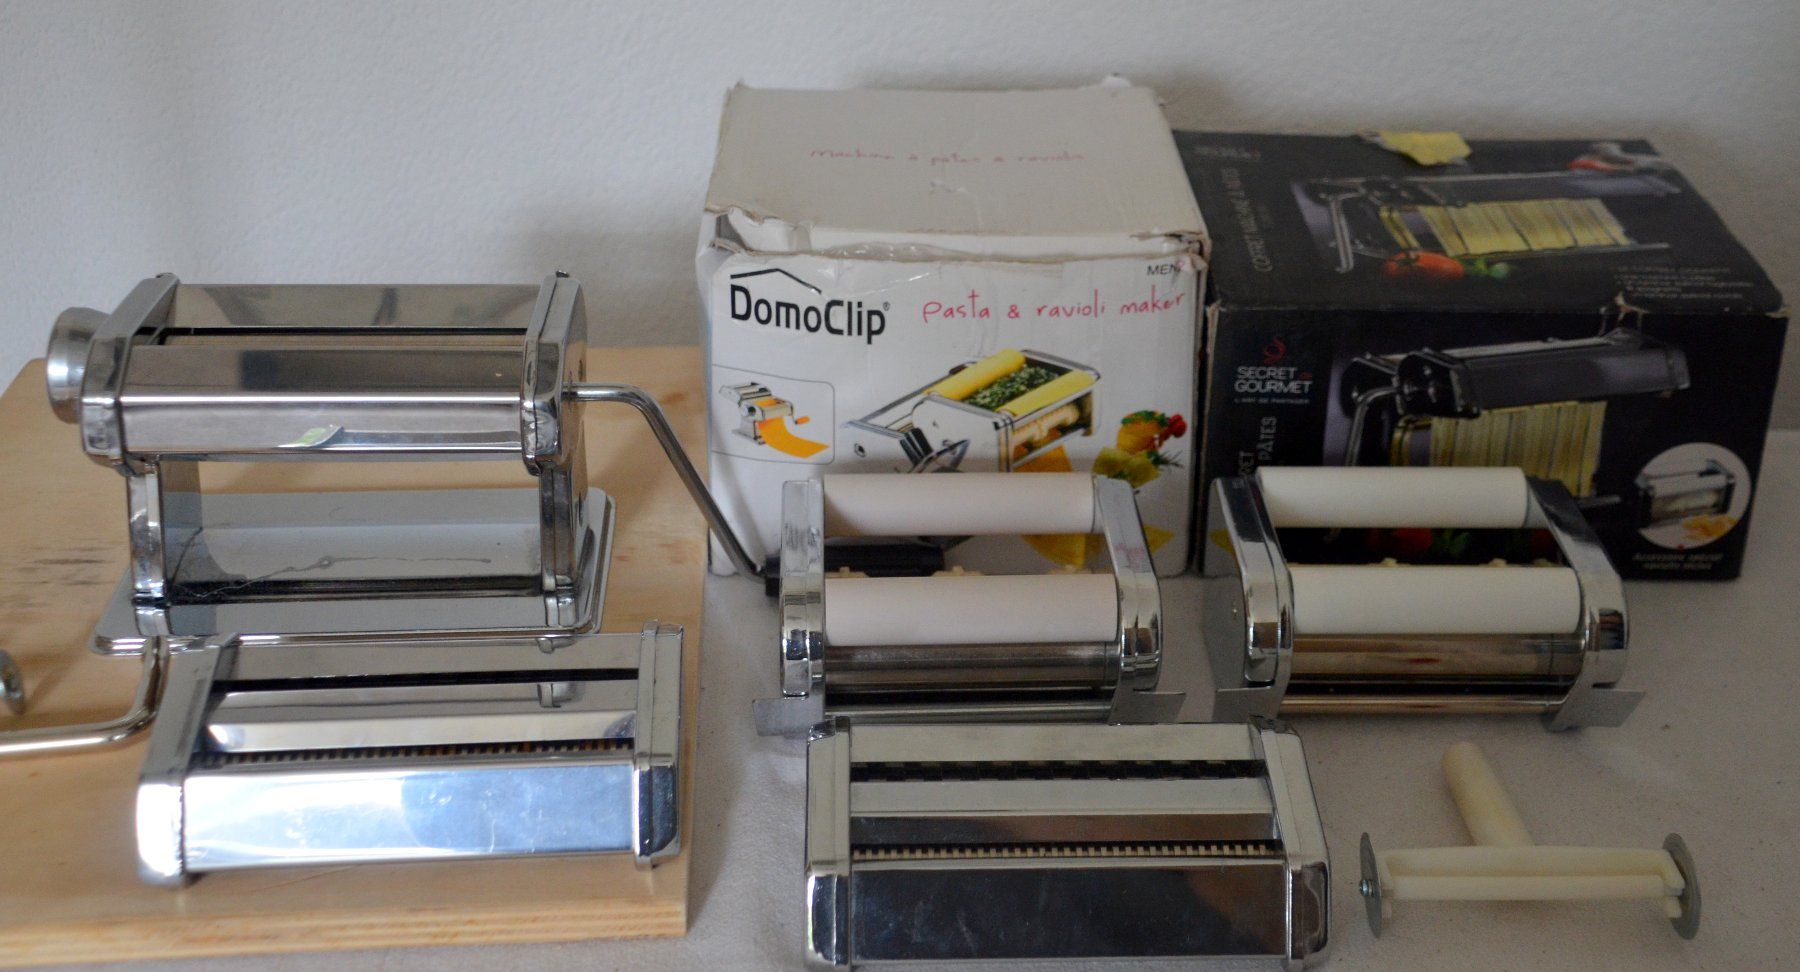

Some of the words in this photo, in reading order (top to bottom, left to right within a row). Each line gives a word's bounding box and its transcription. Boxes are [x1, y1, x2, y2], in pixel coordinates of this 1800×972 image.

[1008, 304, 1020, 319] &
[1036, 289, 1106, 319] ravioli
[1119, 285, 1185, 315] maker
[1237, 365, 1297, 379] SECRET
[1234, 379, 1313, 393] GOURMET
